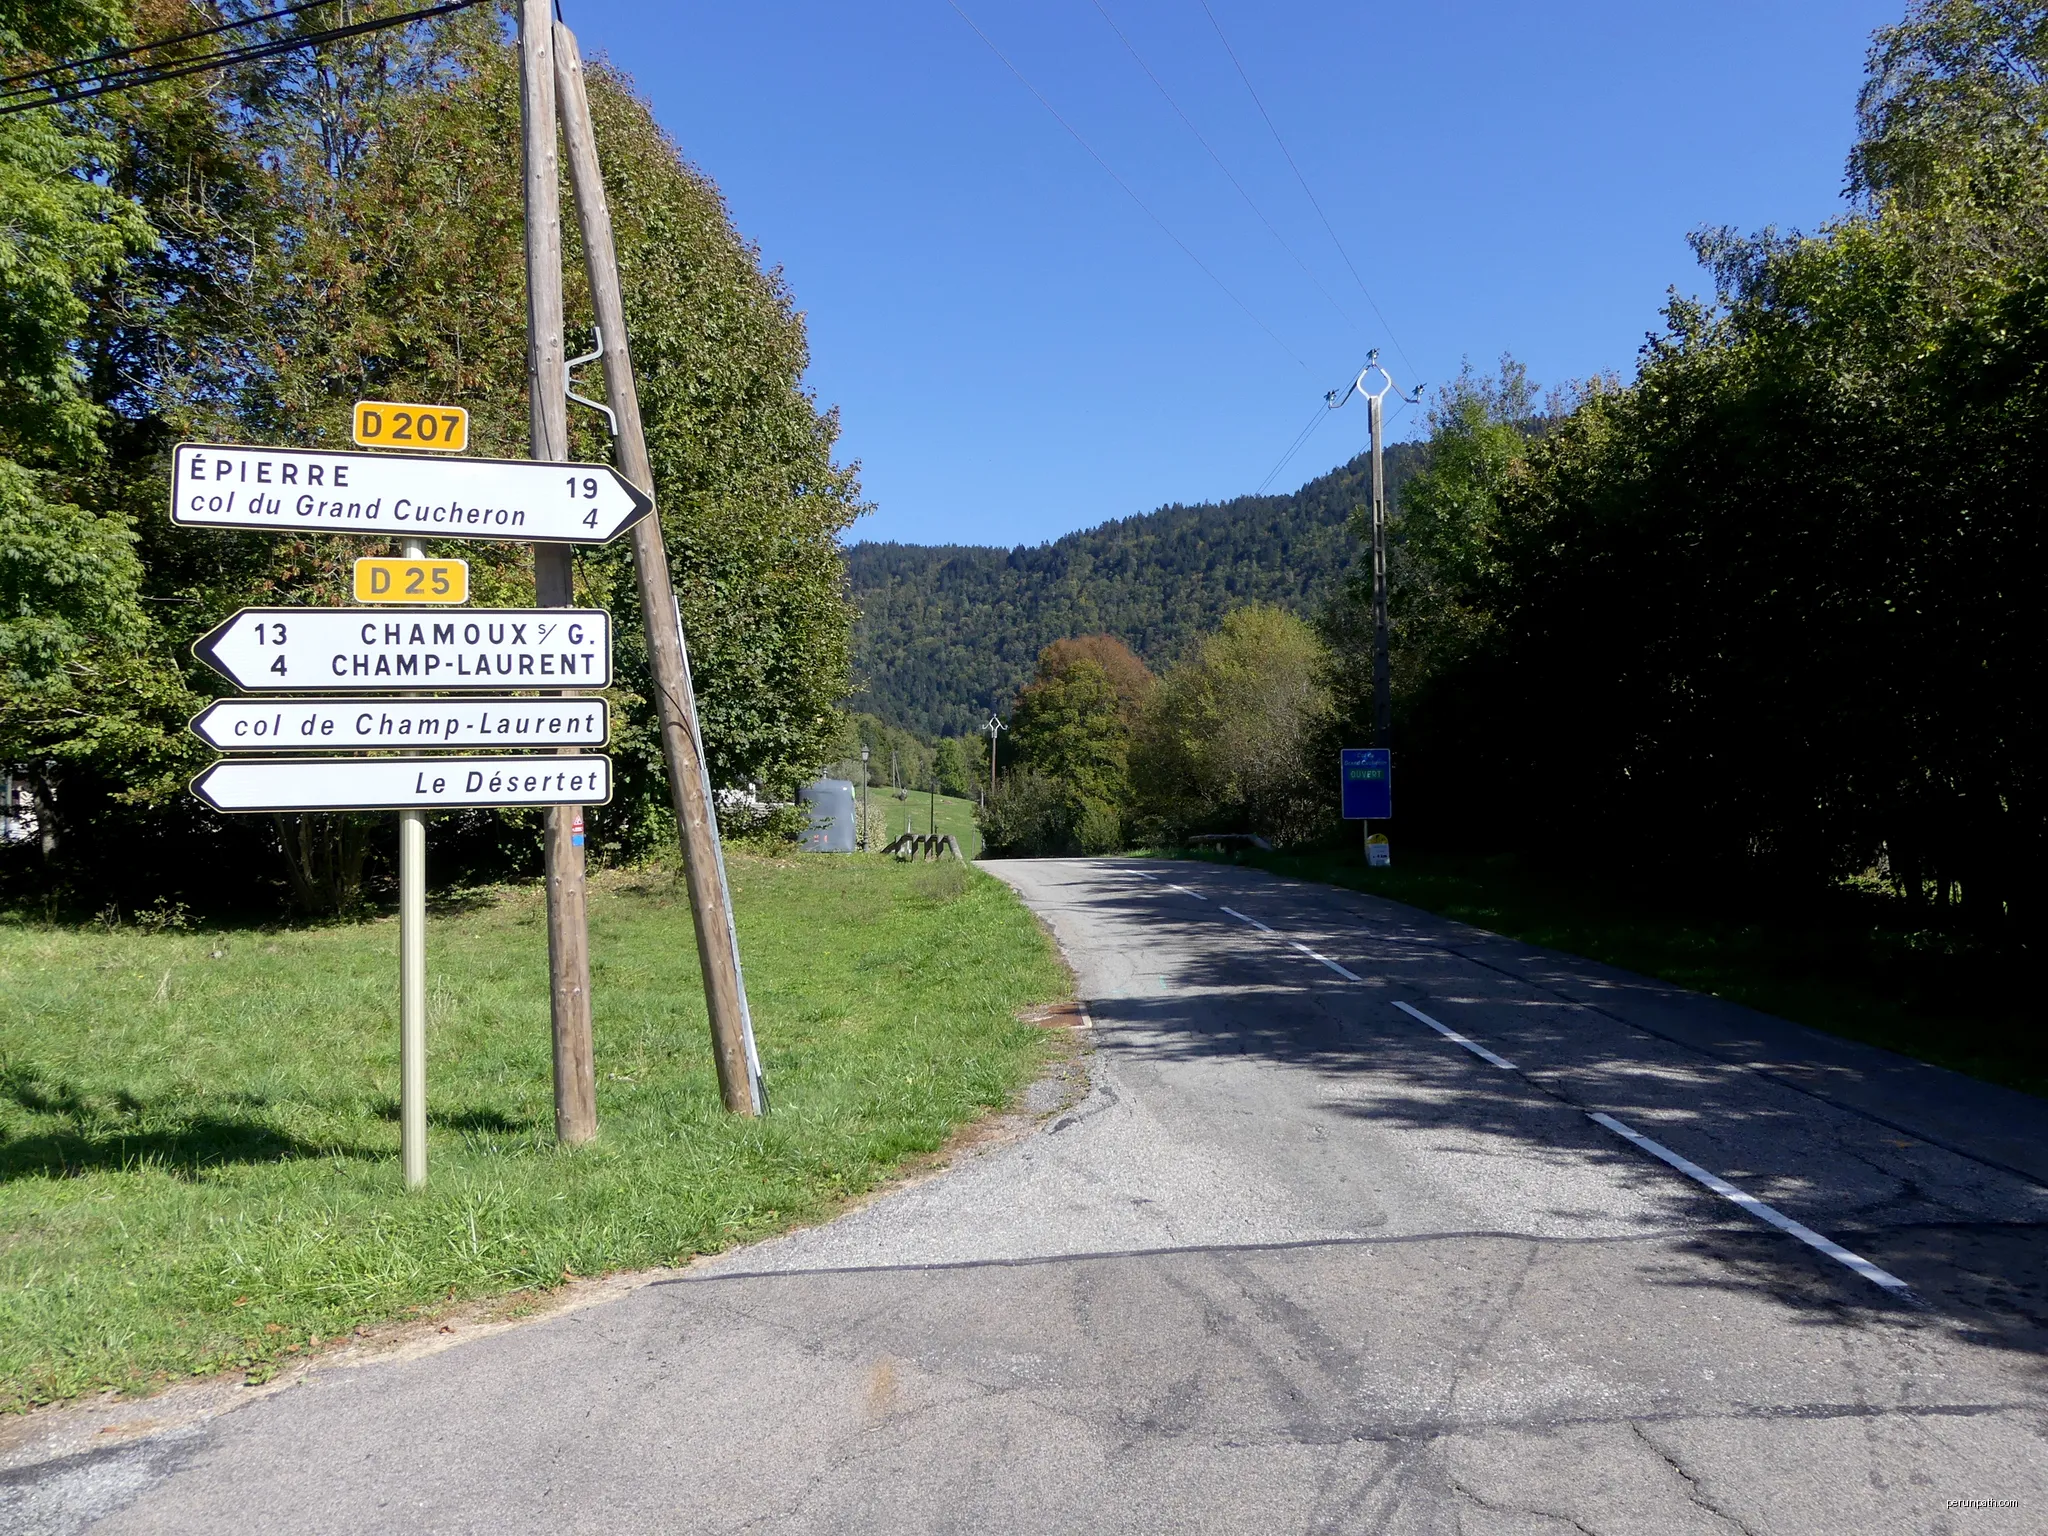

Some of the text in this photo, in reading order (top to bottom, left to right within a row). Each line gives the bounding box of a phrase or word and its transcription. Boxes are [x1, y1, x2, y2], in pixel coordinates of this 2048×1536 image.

[362, 410, 460, 442] D 207
[190, 453, 598, 500] ÉPIERRE 19
[191, 491, 598, 529] col du Grand Cucheron 4
[371, 567, 450, 595] D 25
[254, 623, 287, 646] 13
[361, 623, 527, 645] CHAMOUX
[568, 623, 595, 646] G.
[270, 653, 595, 677] 4 CHAMP-LAURENT
[234, 712, 594, 741] col de Champ-Laurent
[415, 770, 597, 794] Le Désertet
[1350, 770, 1381, 778] OUVERT
